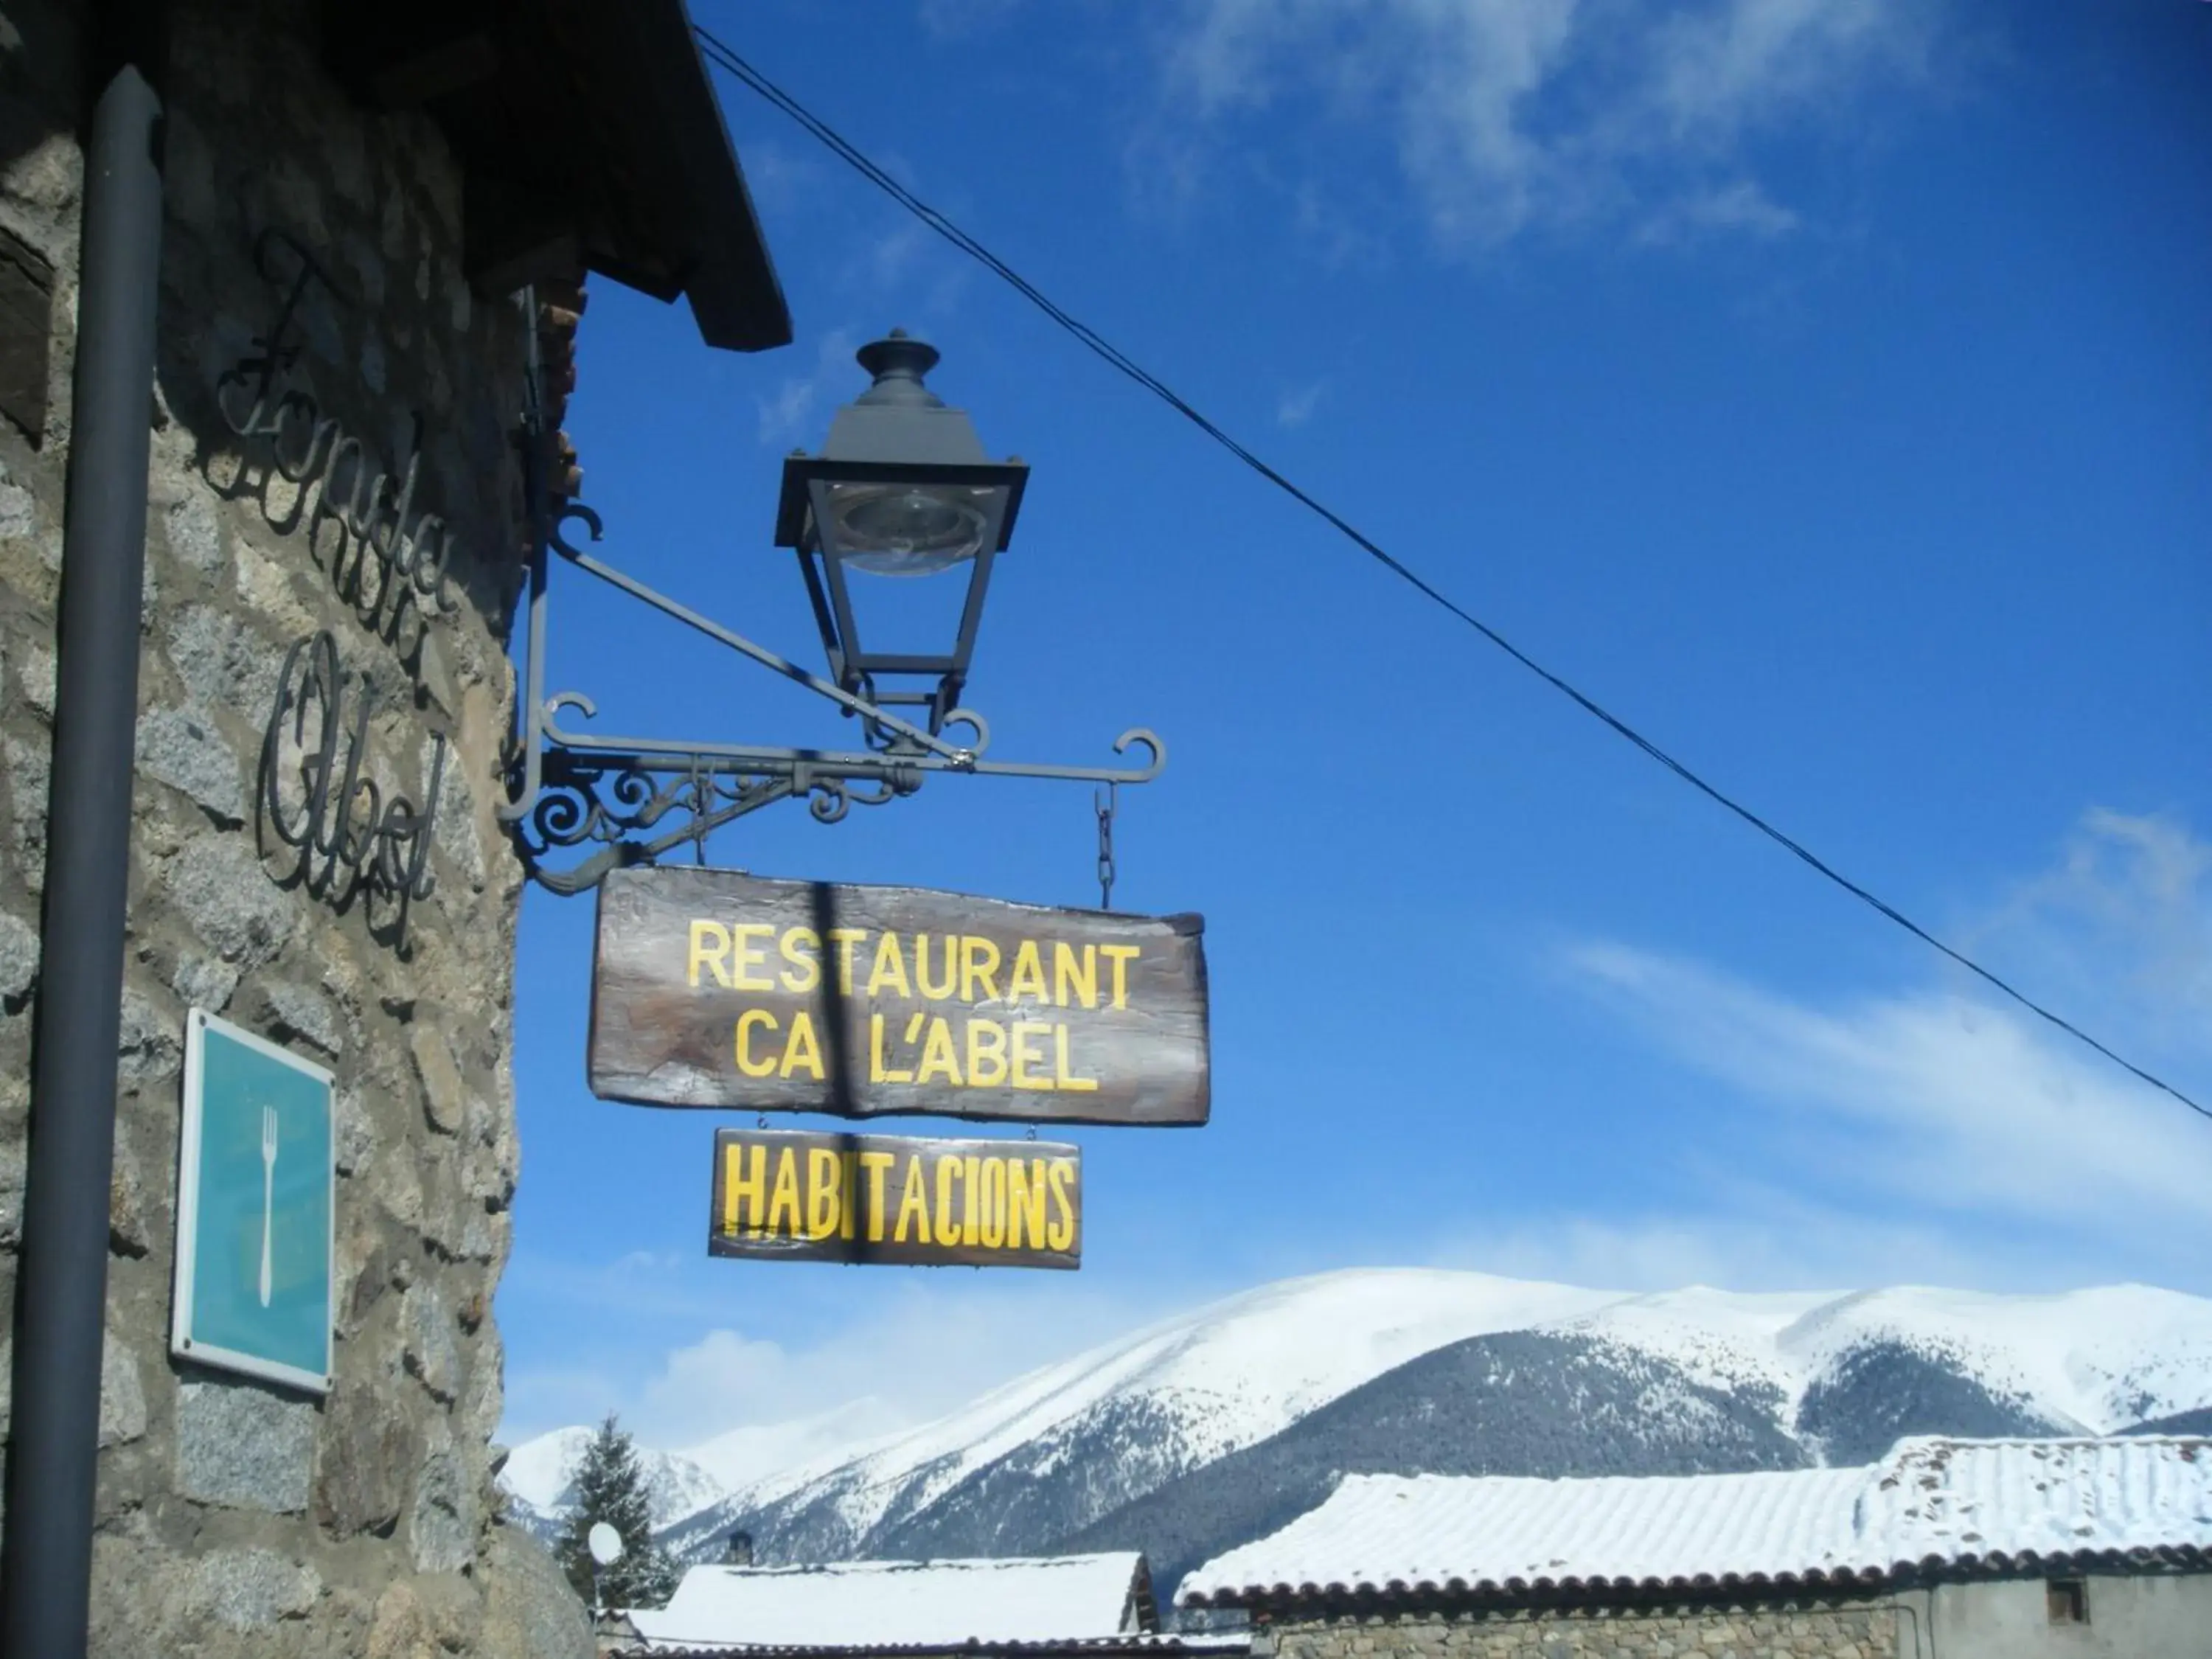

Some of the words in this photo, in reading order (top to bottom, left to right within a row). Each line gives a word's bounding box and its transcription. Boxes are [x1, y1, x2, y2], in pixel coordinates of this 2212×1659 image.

[687, 919, 1140, 1011] RESTAURANT
[736, 1008, 825, 1080] CA
[869, 1012, 1099, 1091] L'ABEL
[723, 1144, 1074, 1252] HABITACIONS
